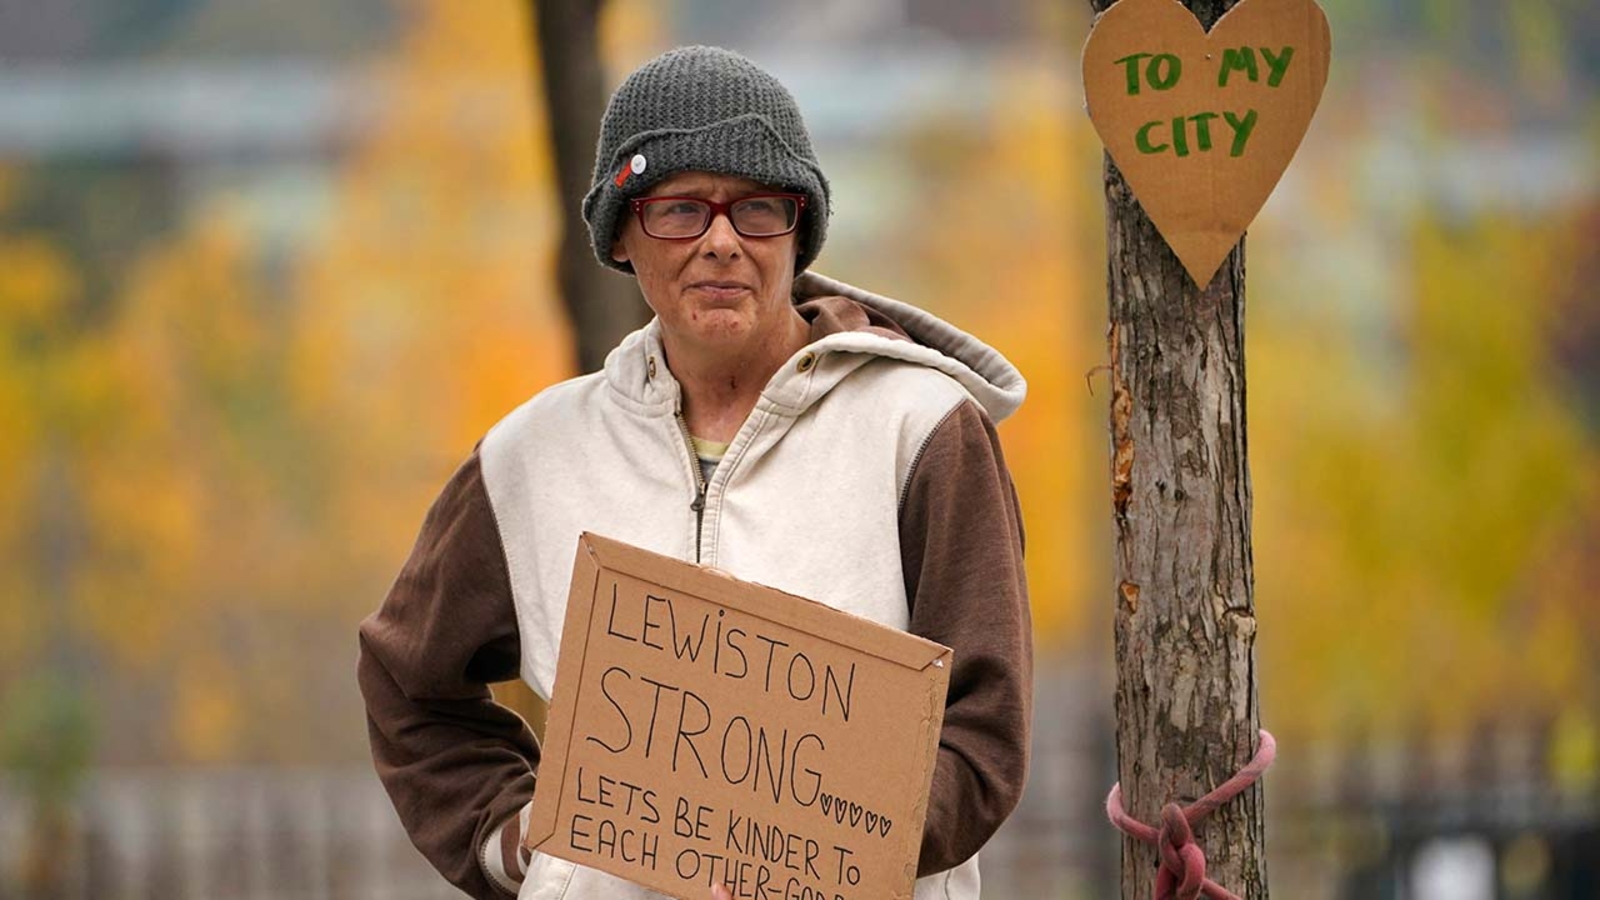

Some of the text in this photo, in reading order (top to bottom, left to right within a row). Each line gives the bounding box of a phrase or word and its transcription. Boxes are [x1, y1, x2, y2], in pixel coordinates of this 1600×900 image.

[1113, 46, 1295, 96] TO MY
[1135, 108, 1258, 158] CITY
[586, 666, 826, 807] STRONG
[570, 814, 660, 872] EACH
[576, 766, 661, 824] LETS
[674, 796, 714, 841] BE
[725, 809, 821, 881] KINDER
